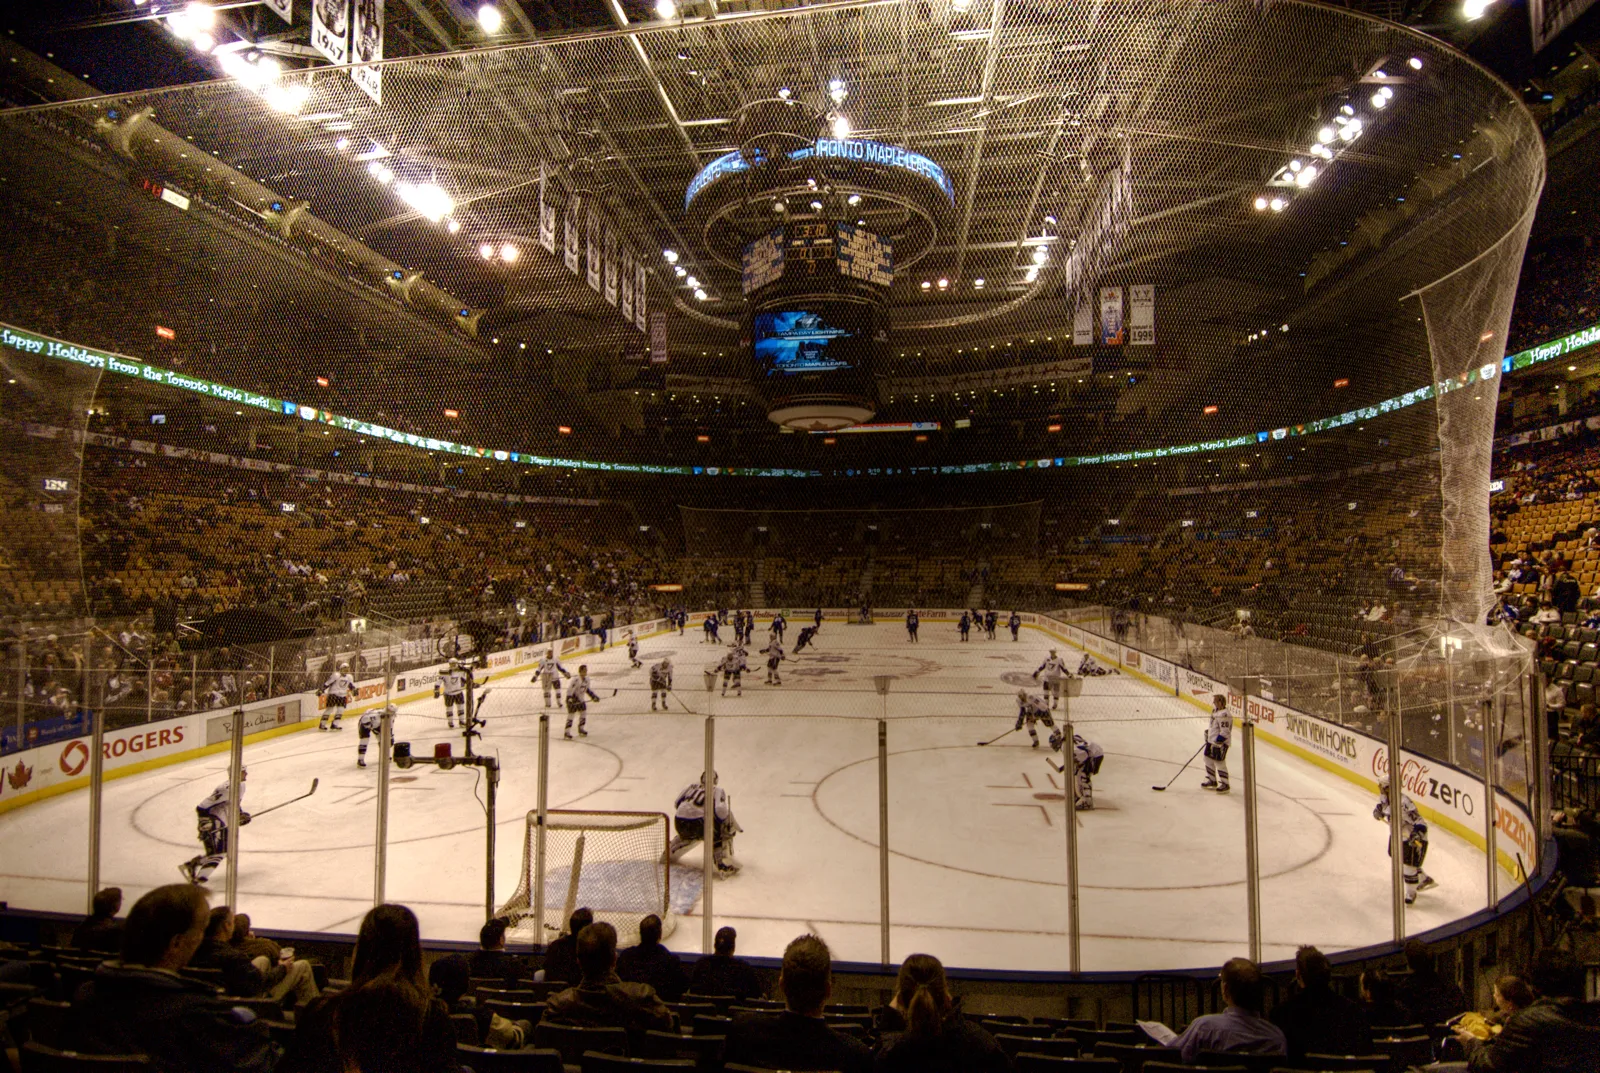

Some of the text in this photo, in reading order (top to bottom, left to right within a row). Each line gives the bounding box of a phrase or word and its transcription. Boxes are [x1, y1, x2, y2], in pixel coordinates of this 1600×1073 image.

[317, 30, 344, 60] 1947
[866, 143, 904, 168] MAPLE
[905, 152, 932, 178] LEAFS
[1530, 341, 1562, 364] Happy
[47, 342, 104, 367] Holidays
[108, 356, 139, 375] from
[143, 366, 162, 382] the
[165, 371, 208, 393] Toronto
[211, 383, 242, 402] Maple
[530, 455, 552, 467] Happy
[552, 458, 581, 468] Holidays
[582, 460, 599, 470] from
[600, 462, 611, 471] the
[612, 463, 640, 472] Toronto
[642, 464, 662, 474] Maple
[1077, 456, 1101, 465] Happy
[1102, 452, 1132, 463] Holidays
[1134, 449, 1154, 460] from
[1155, 447, 1167, 457] the
[1169, 444, 1198, 455] Toronto
[1200, 440, 1225, 452] Maple
[44, 479, 68, 491] IBM
[1228, 692, 1275, 723] redag.ca
[102, 725, 184, 759] ROGERS
[1286, 713, 1357, 759] SUMMIT VIEW HOMES
[1429, 777, 1474, 816] zero
